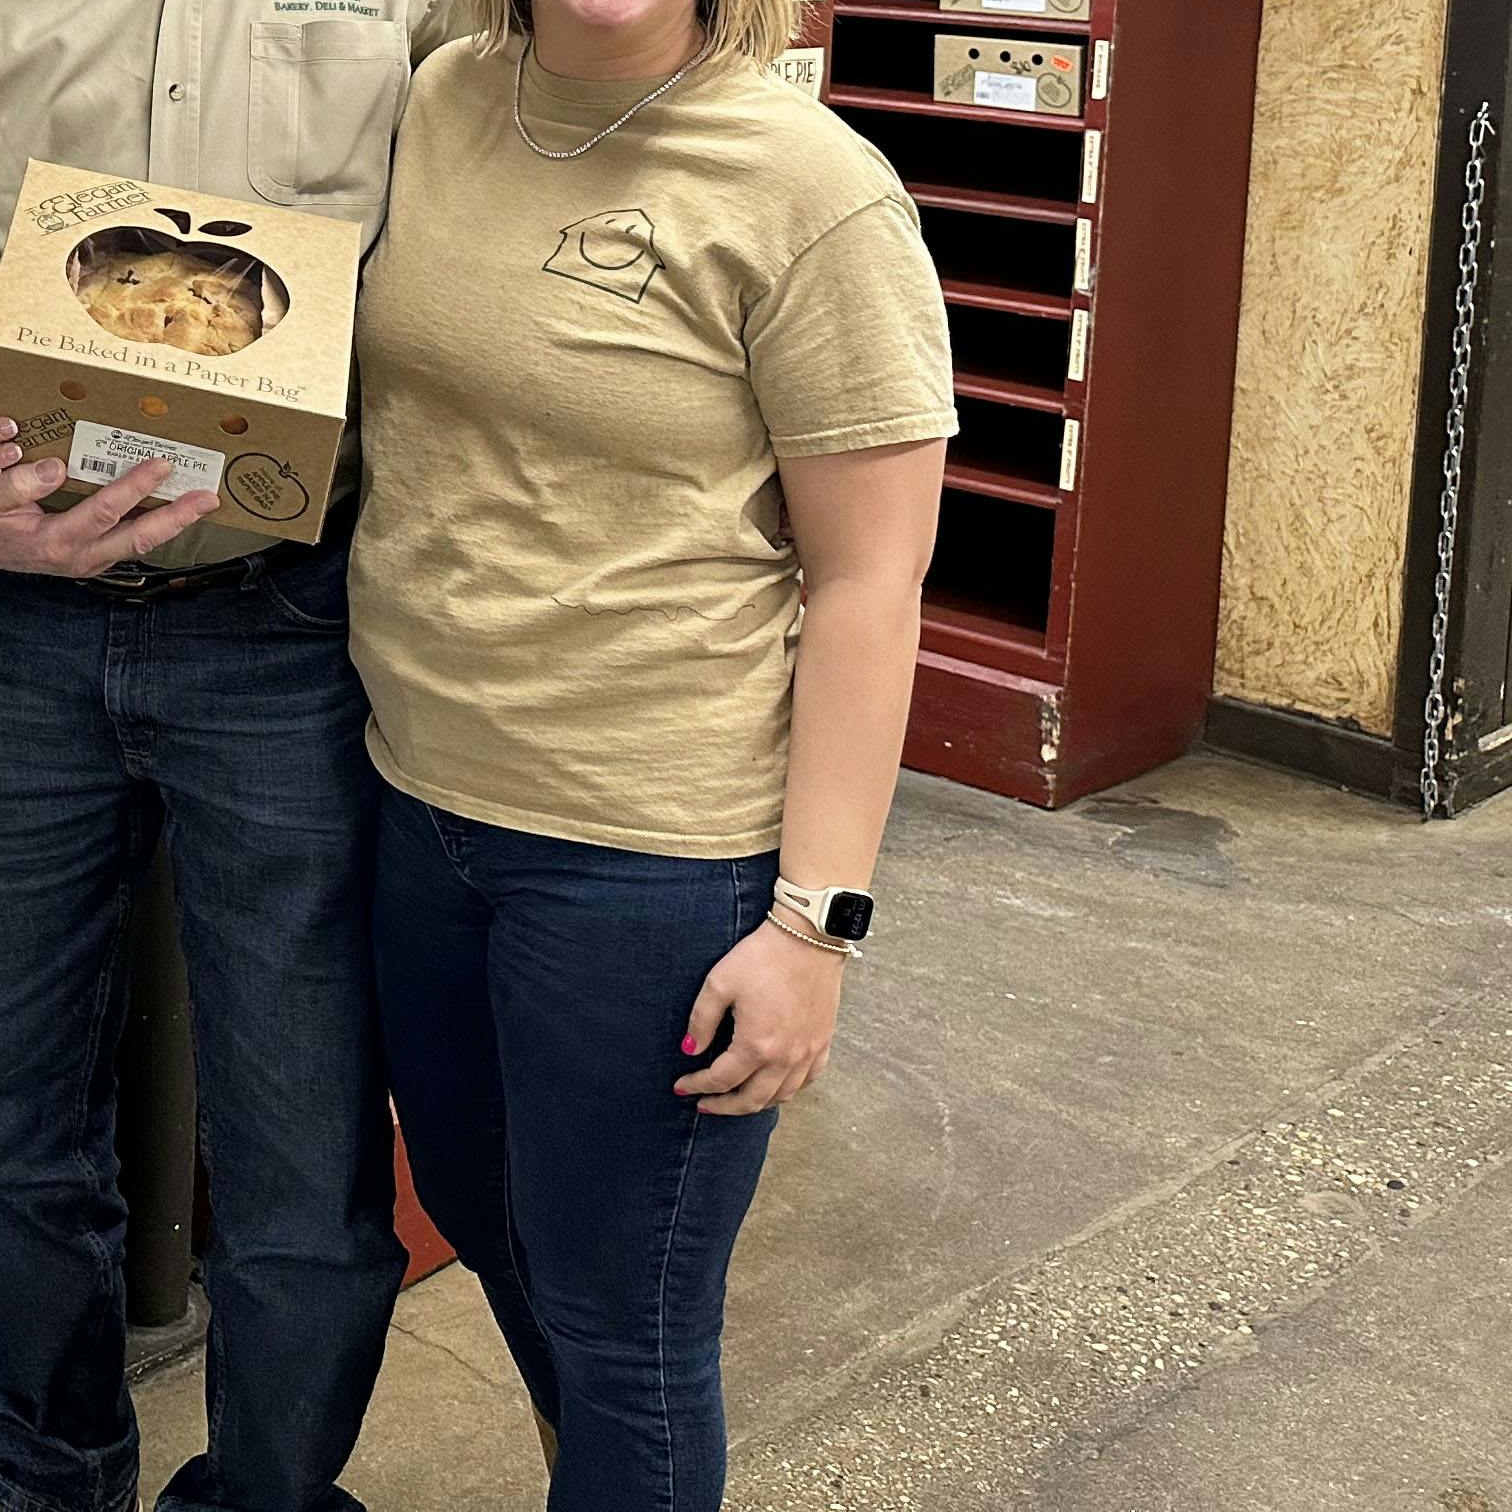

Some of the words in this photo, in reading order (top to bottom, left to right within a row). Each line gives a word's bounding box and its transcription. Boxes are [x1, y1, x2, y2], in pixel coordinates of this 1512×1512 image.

[347, 2, 379, 17] MARKET
[796, 61, 814, 84] PIE
[39, 180, 142, 215] Elegant
[72, 191, 150, 223] Farmer
[16, 325, 51, 349] Pie
[59, 334, 128, 366] Baked
[135, 351, 157, 369] in
[164, 360, 177, 374] a
[186, 360, 250, 393] Paper
[108, 440, 155, 461] ORIGINAL
[192, 460, 209, 473] PIE
